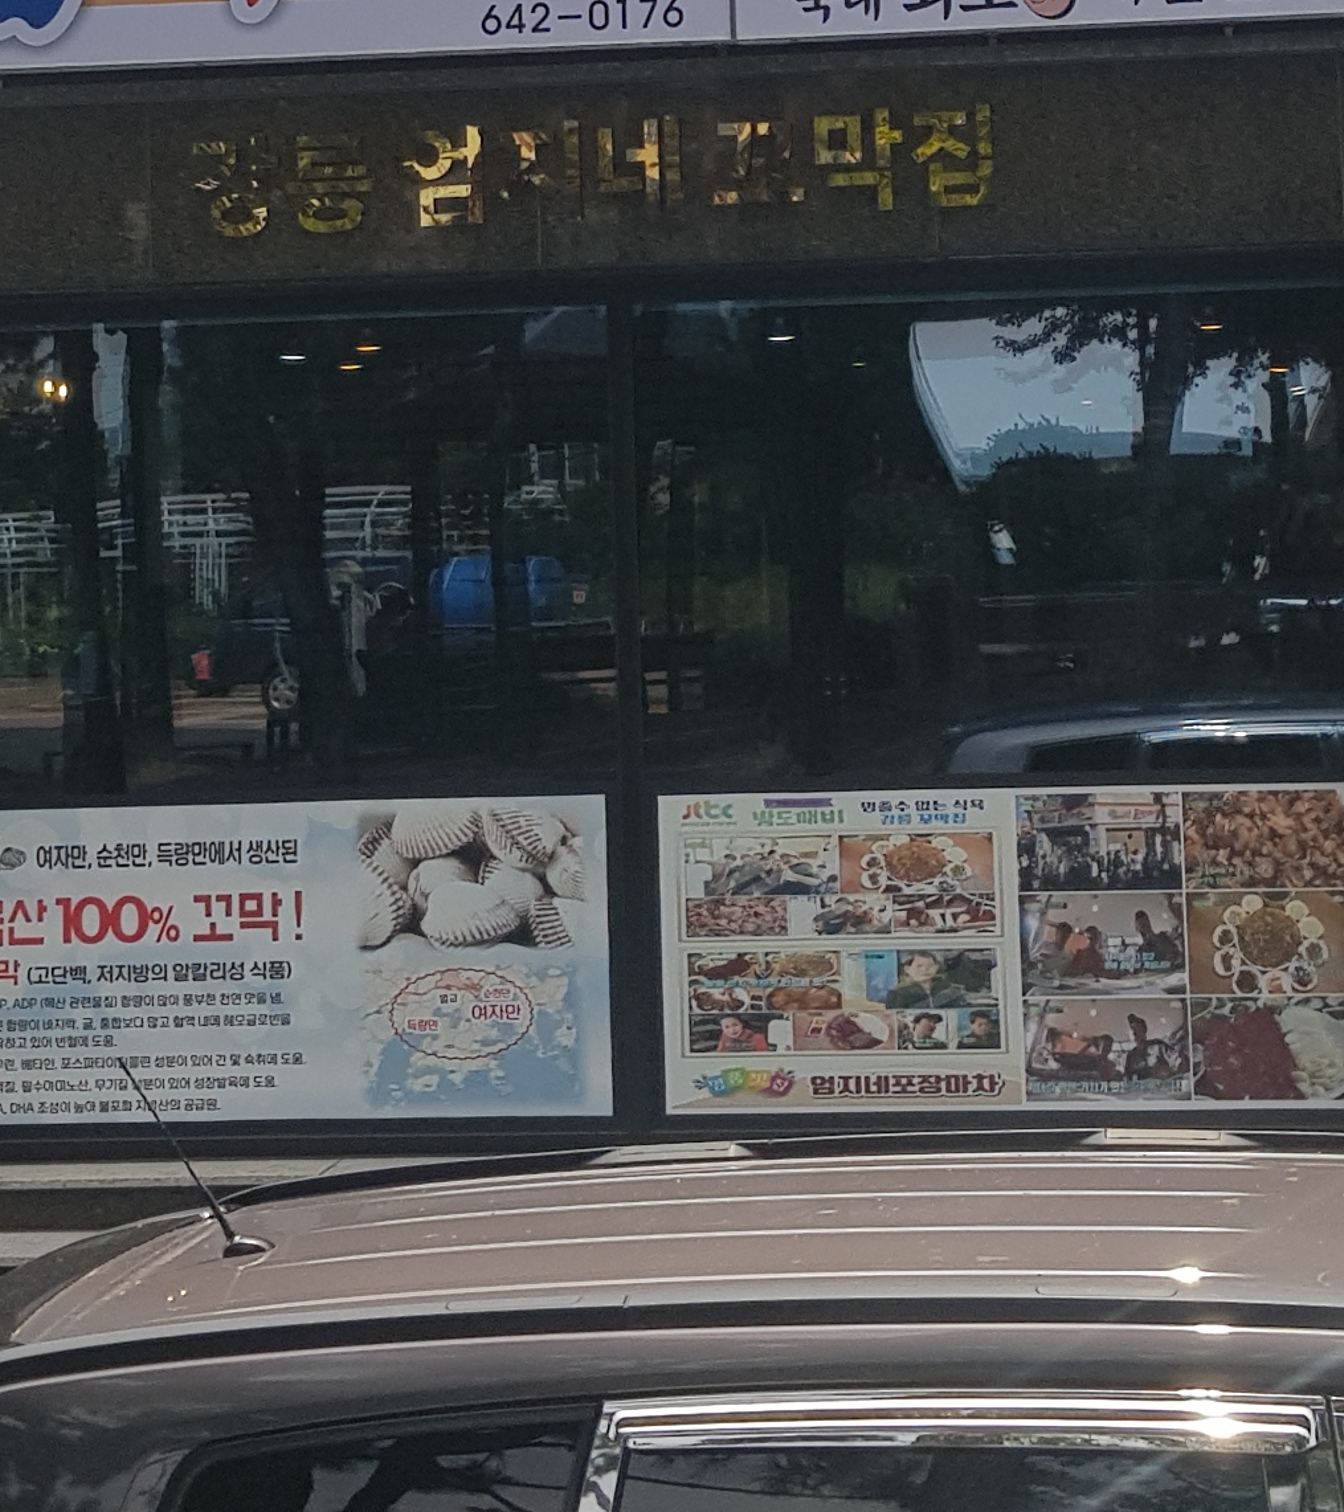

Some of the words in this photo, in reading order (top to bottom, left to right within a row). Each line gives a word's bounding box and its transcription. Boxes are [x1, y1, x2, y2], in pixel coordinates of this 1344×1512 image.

[36, 844, 92, 870] 여자만,
[96, 843, 152, 868] 순천만,
[157, 840, 242, 866] 득량만에서
[246, 839, 298, 865] 생산된
[55, 895, 180, 944] 100%
[97, 963, 167, 983] 저지방의
[173, 961, 244, 982] 알칼리성
[250, 960, 292, 981] 식품)
[472, 1004, 521, 1020] 여자만
[810, 1073, 1005, 1097] 엄지네포장마차
